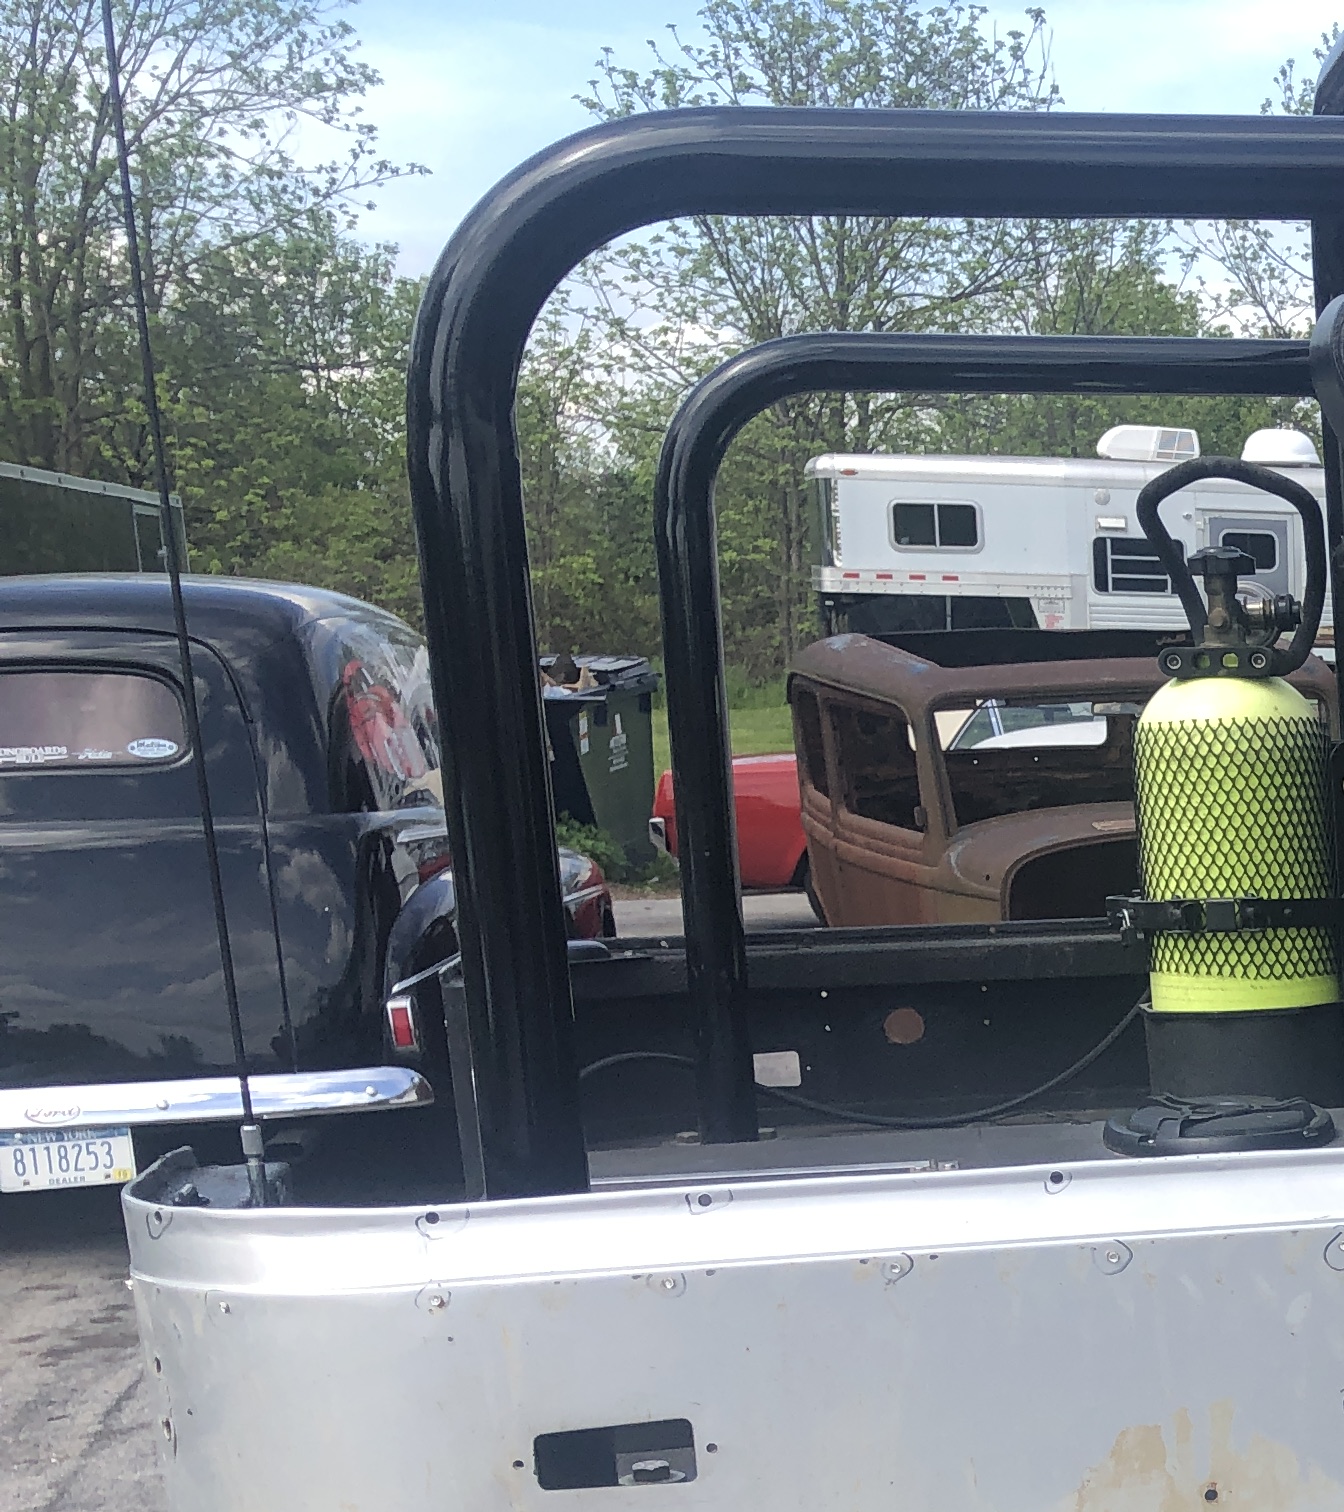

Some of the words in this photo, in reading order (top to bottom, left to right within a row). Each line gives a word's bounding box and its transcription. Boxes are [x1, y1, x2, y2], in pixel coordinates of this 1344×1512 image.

[28, 1131, 57, 1144] NEW
[62, 1128, 97, 1141] YORK
[13, 1140, 114, 1177] 8118253
[48, 1176, 86, 1186] DEALER
